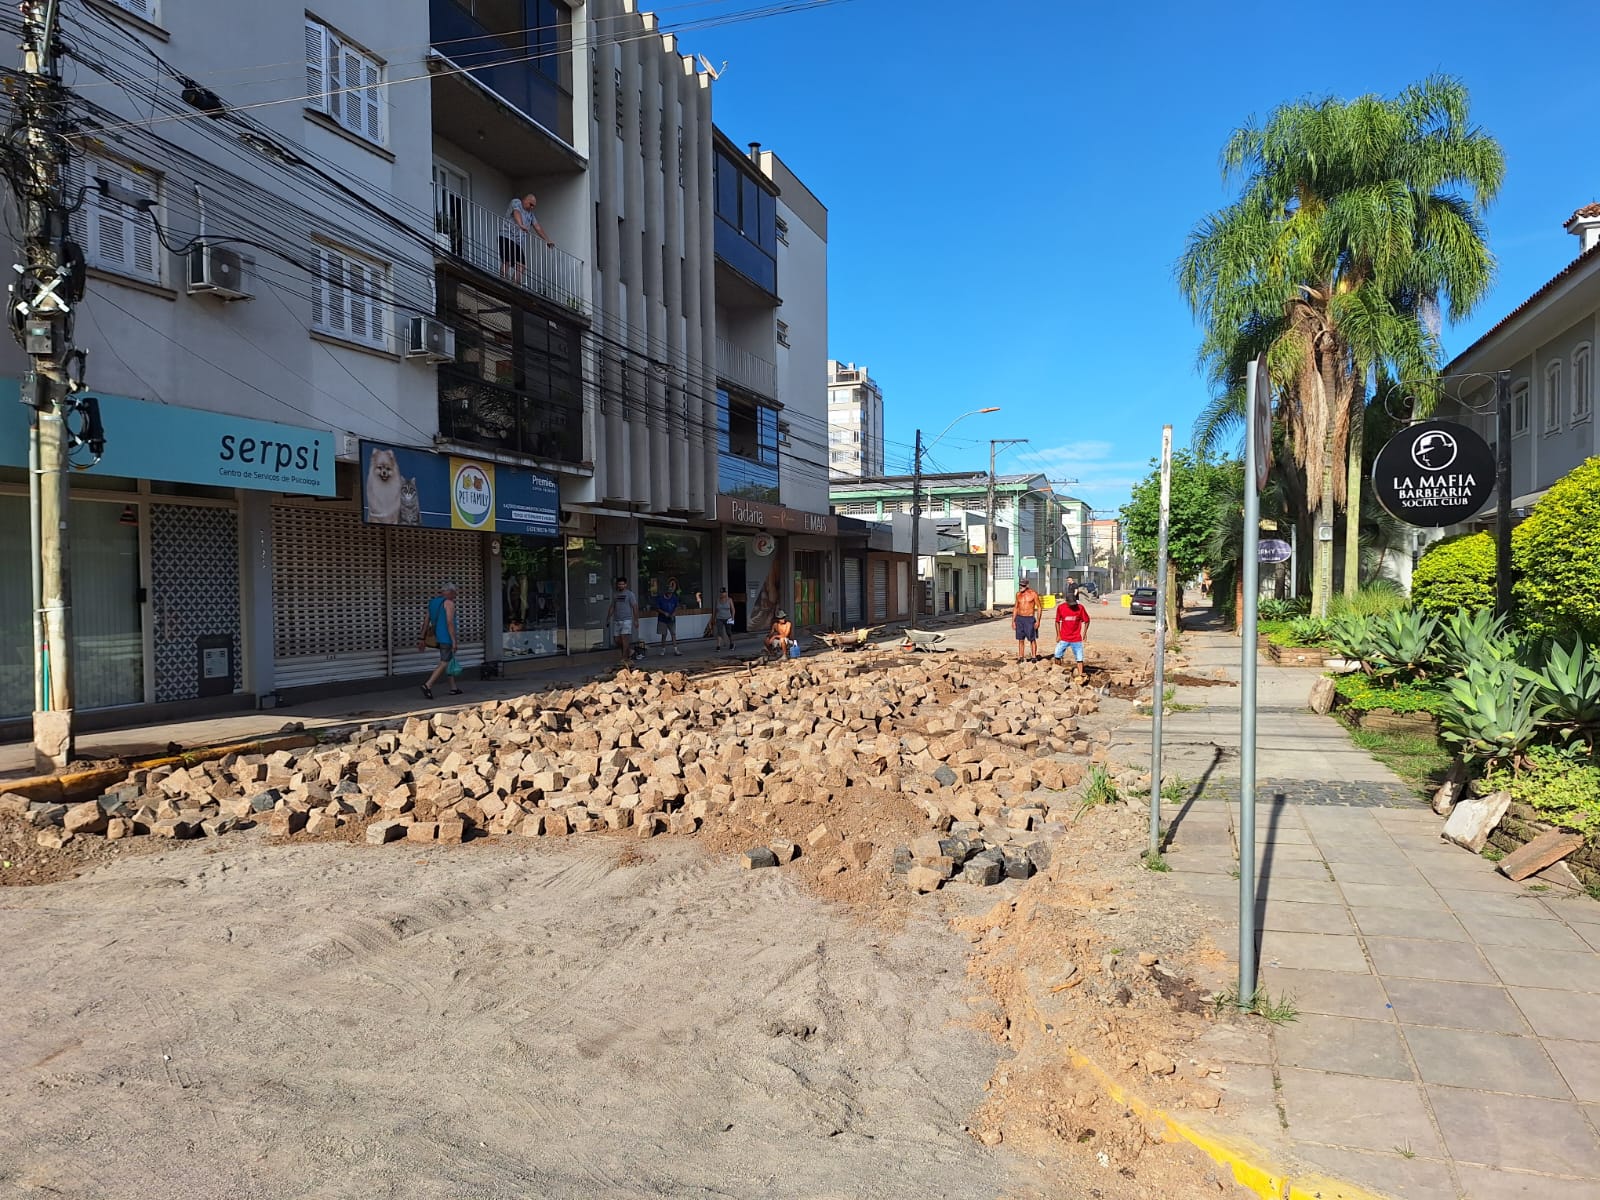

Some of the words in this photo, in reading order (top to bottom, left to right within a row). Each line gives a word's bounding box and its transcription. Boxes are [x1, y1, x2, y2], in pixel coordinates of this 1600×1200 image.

[220, 435, 320, 472] serpsi
[219, 467, 242, 477] Centro
[243, 471, 253, 479] de
[1393, 477, 1413, 489] LA
[1420, 474, 1476, 488] MAFIA
[459, 490, 468, 504] PET
[470, 491, 488, 506] FAMILY
[1399, 487, 1472, 499] BARBEARIA
[1402, 499, 1438, 507] SOCIAL
[732, 501, 764, 524] Padaria
